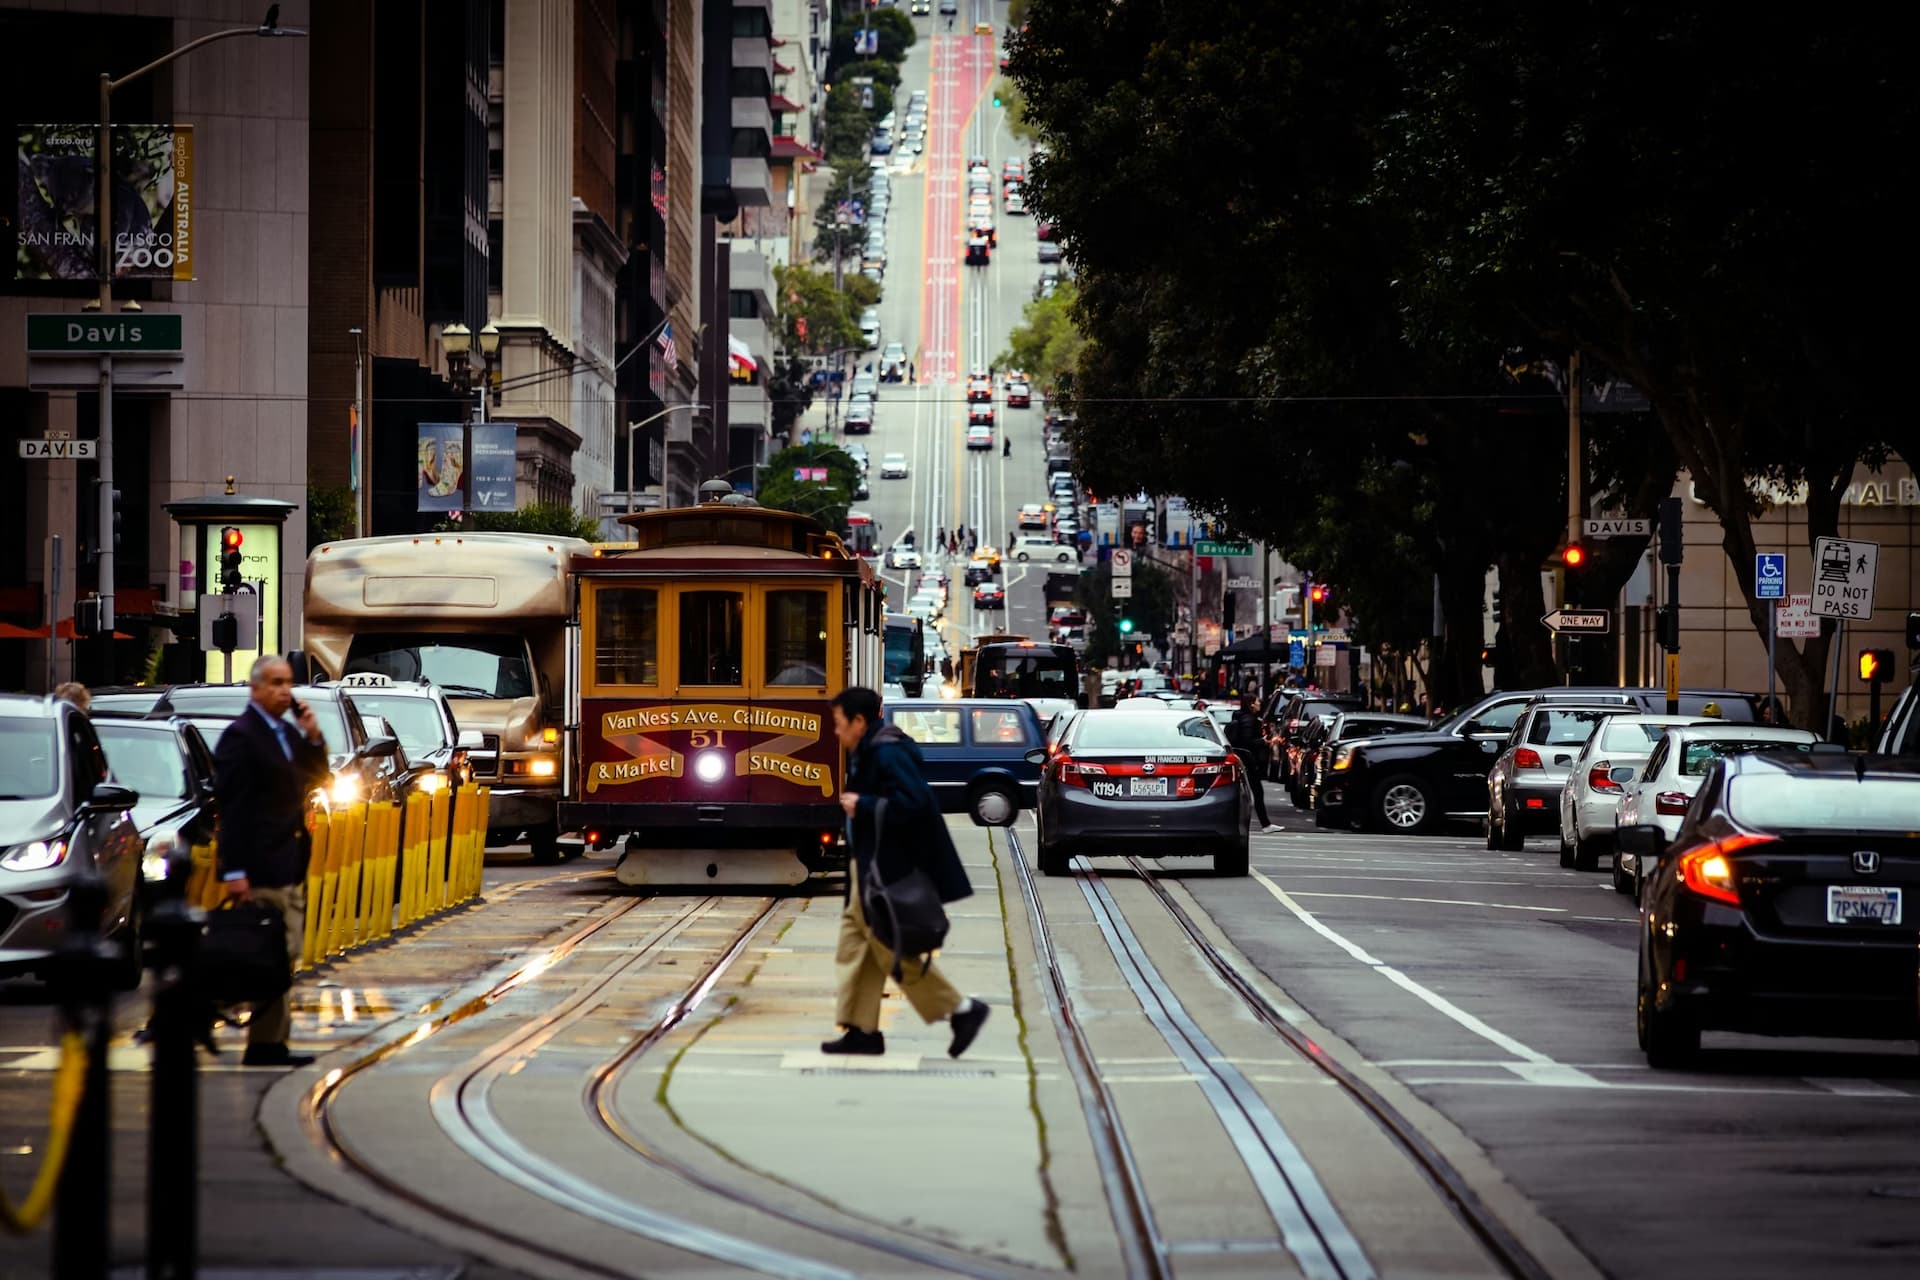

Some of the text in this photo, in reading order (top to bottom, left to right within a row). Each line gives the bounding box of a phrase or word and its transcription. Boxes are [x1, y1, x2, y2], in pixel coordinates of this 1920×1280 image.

[45, 136, 93, 147] sfzoo.org
[176, 136, 189, 264] explore AUSTRALIA
[18, 232, 94, 246] SAN FRAN
[115, 232, 173, 247] CISCO
[116, 248, 174, 268] ZOO
[67, 323, 143, 342] Davis
[26, 443, 88, 455] DAVIS
[1589, 522, 1643, 533] DAVIS
[215, 555, 268, 563] eron
[1758, 577, 1783, 585] PARKING
[1817, 584, 1868, 600] DO NOT
[1791, 598, 1809, 606] PARKI
[1824, 601, 1859, 615] PASS
[1560, 616, 1601, 625] ONE WAY
[347, 677, 385, 686] TAXI
[607, 714, 636, 730] Van
[639, 709, 679, 727] Ness
[733, 708, 818, 732] California
[690, 730, 726, 748] 51
[598, 757, 676, 779] & Market
[750, 755, 821, 780] Streets
